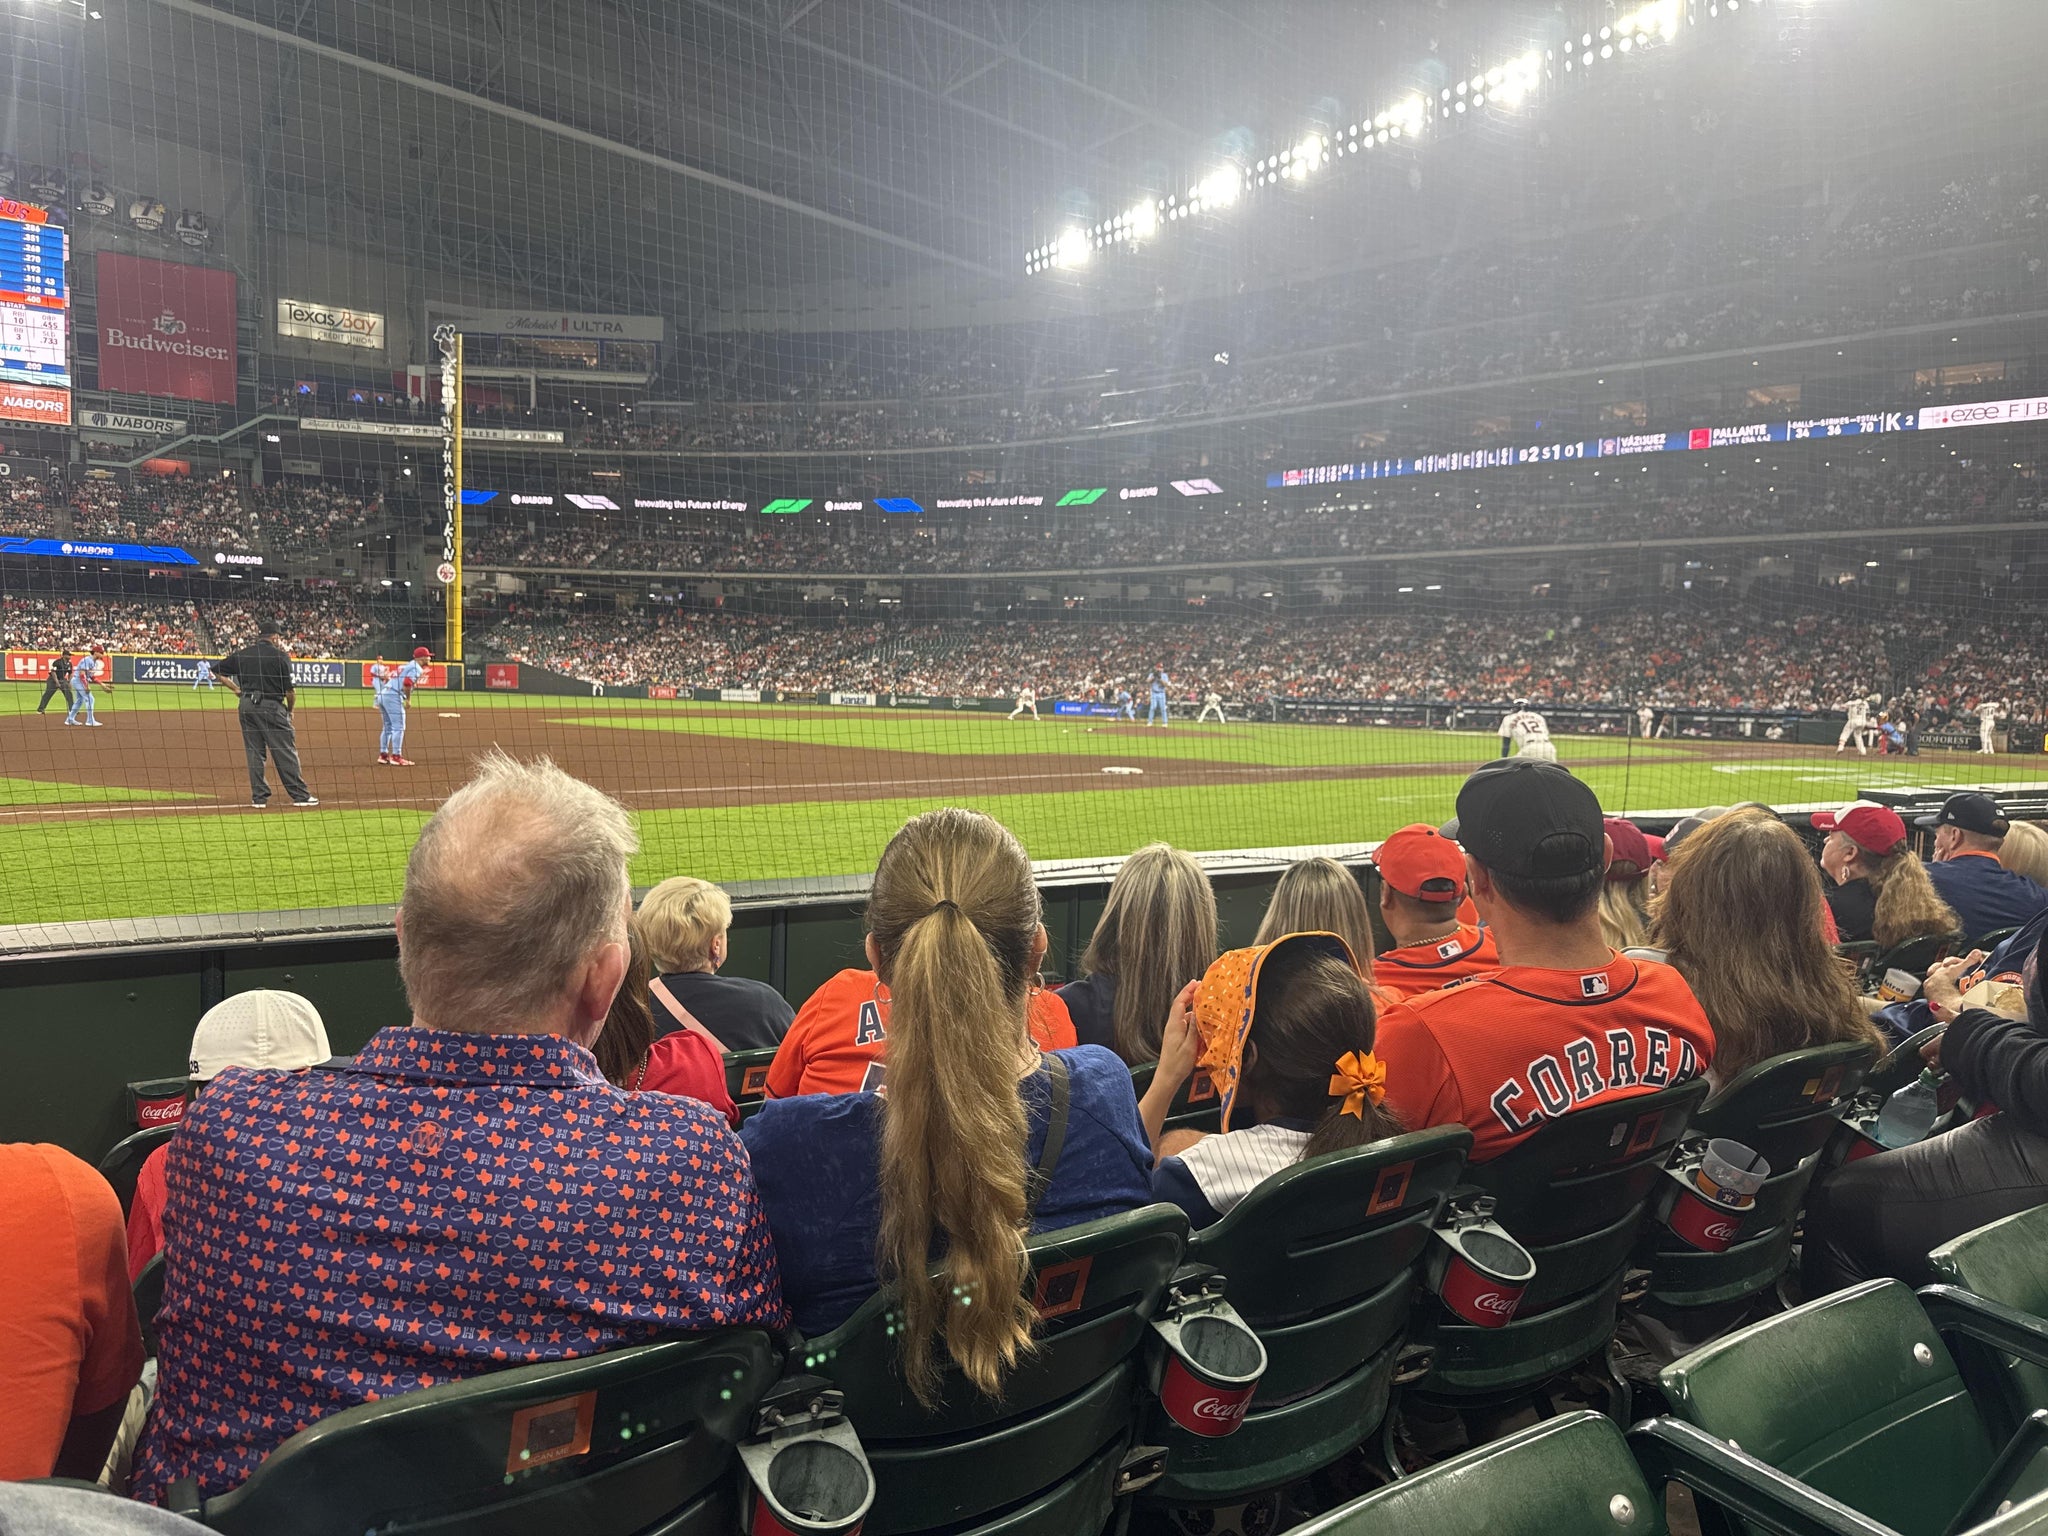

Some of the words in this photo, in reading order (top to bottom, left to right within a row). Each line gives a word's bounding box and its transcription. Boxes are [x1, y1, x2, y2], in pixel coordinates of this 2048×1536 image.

[14, 317, 24, 325] 10
[285, 303, 335, 326] Texas
[340, 311, 376, 336] Bay
[573, 321, 623, 333] ULTRA
[16, 333, 21, 341] 3
[317, 330, 345, 341] CREDIT
[347, 335, 374, 345] UNION
[4, 397, 64, 413] NABORS
[1951, 406, 2000, 422] ezee
[112, 417, 174, 433] NABORS
[1860, 422, 1874, 433] 70
[1885, 412, 1901, 431] K
[1905, 415, 1914, 426] 2
[1712, 423, 1768, 440] PALLANTE
[635, 499, 673, 510] Innovating
[674, 500, 687, 509] the
[688, 500, 711, 510] Future
[712, 500, 720, 510] of
[721, 501, 747, 512] Energy
[937, 498, 973, 509] Innovating
[973, 498, 985, 507] the
[986, 496, 1009, 507] Future
[1010, 495, 1019, 505] of
[1019, 495, 1044, 506] Energy
[443, 482, 456, 561] CHIKIN
[74, 544, 114, 556] NABORS
[226, 553, 263, 565] NABORS
[1521, 721, 1542, 734] 12
[141, 1101, 185, 1120] Coca-Cola
